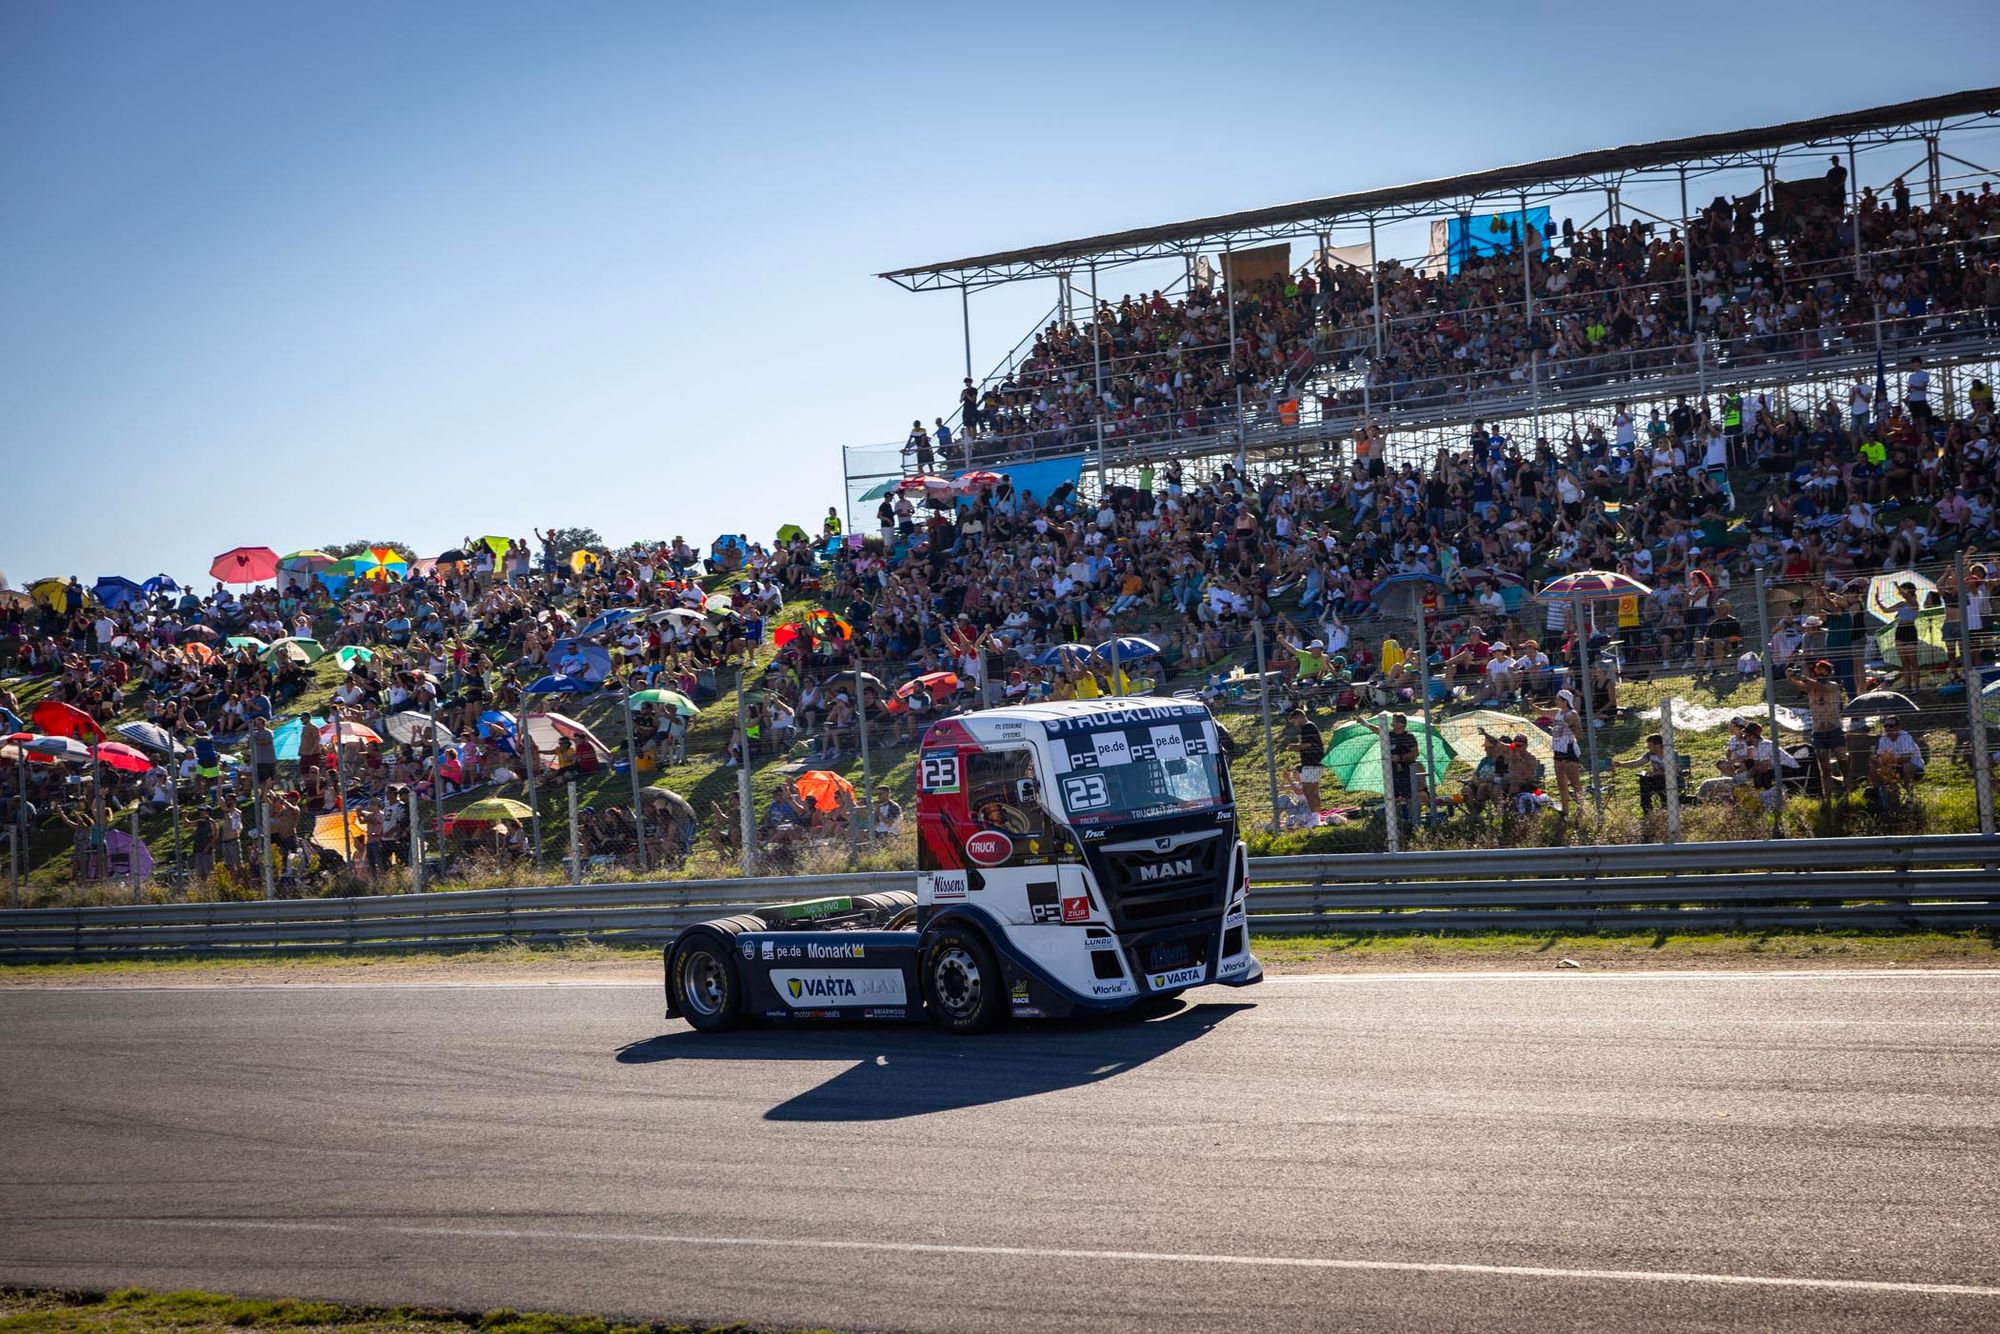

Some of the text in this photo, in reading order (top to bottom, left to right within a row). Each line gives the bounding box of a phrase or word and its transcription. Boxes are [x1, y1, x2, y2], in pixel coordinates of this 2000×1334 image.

[1061, 707, 1183, 729] TRUCKLINE
[1098, 741, 1125, 756] pe.de
[1155, 734, 1181, 748] pe.de
[925, 758, 956, 787] 23
[1067, 775, 1108, 810] 23
[1084, 829, 1106, 839] Trux
[971, 841, 996, 854] TRUCK
[1140, 859, 1193, 881] MAN
[933, 876, 965, 893] Nissens
[803, 901, 839, 915] 100% HVO
[776, 944, 802, 960] pe.de
[807, 942, 851, 959] Monark
[1166, 969, 1200, 985] VARTA
[803, 978, 857, 997] VARTA
[1092, 984, 1122, 995] Works
